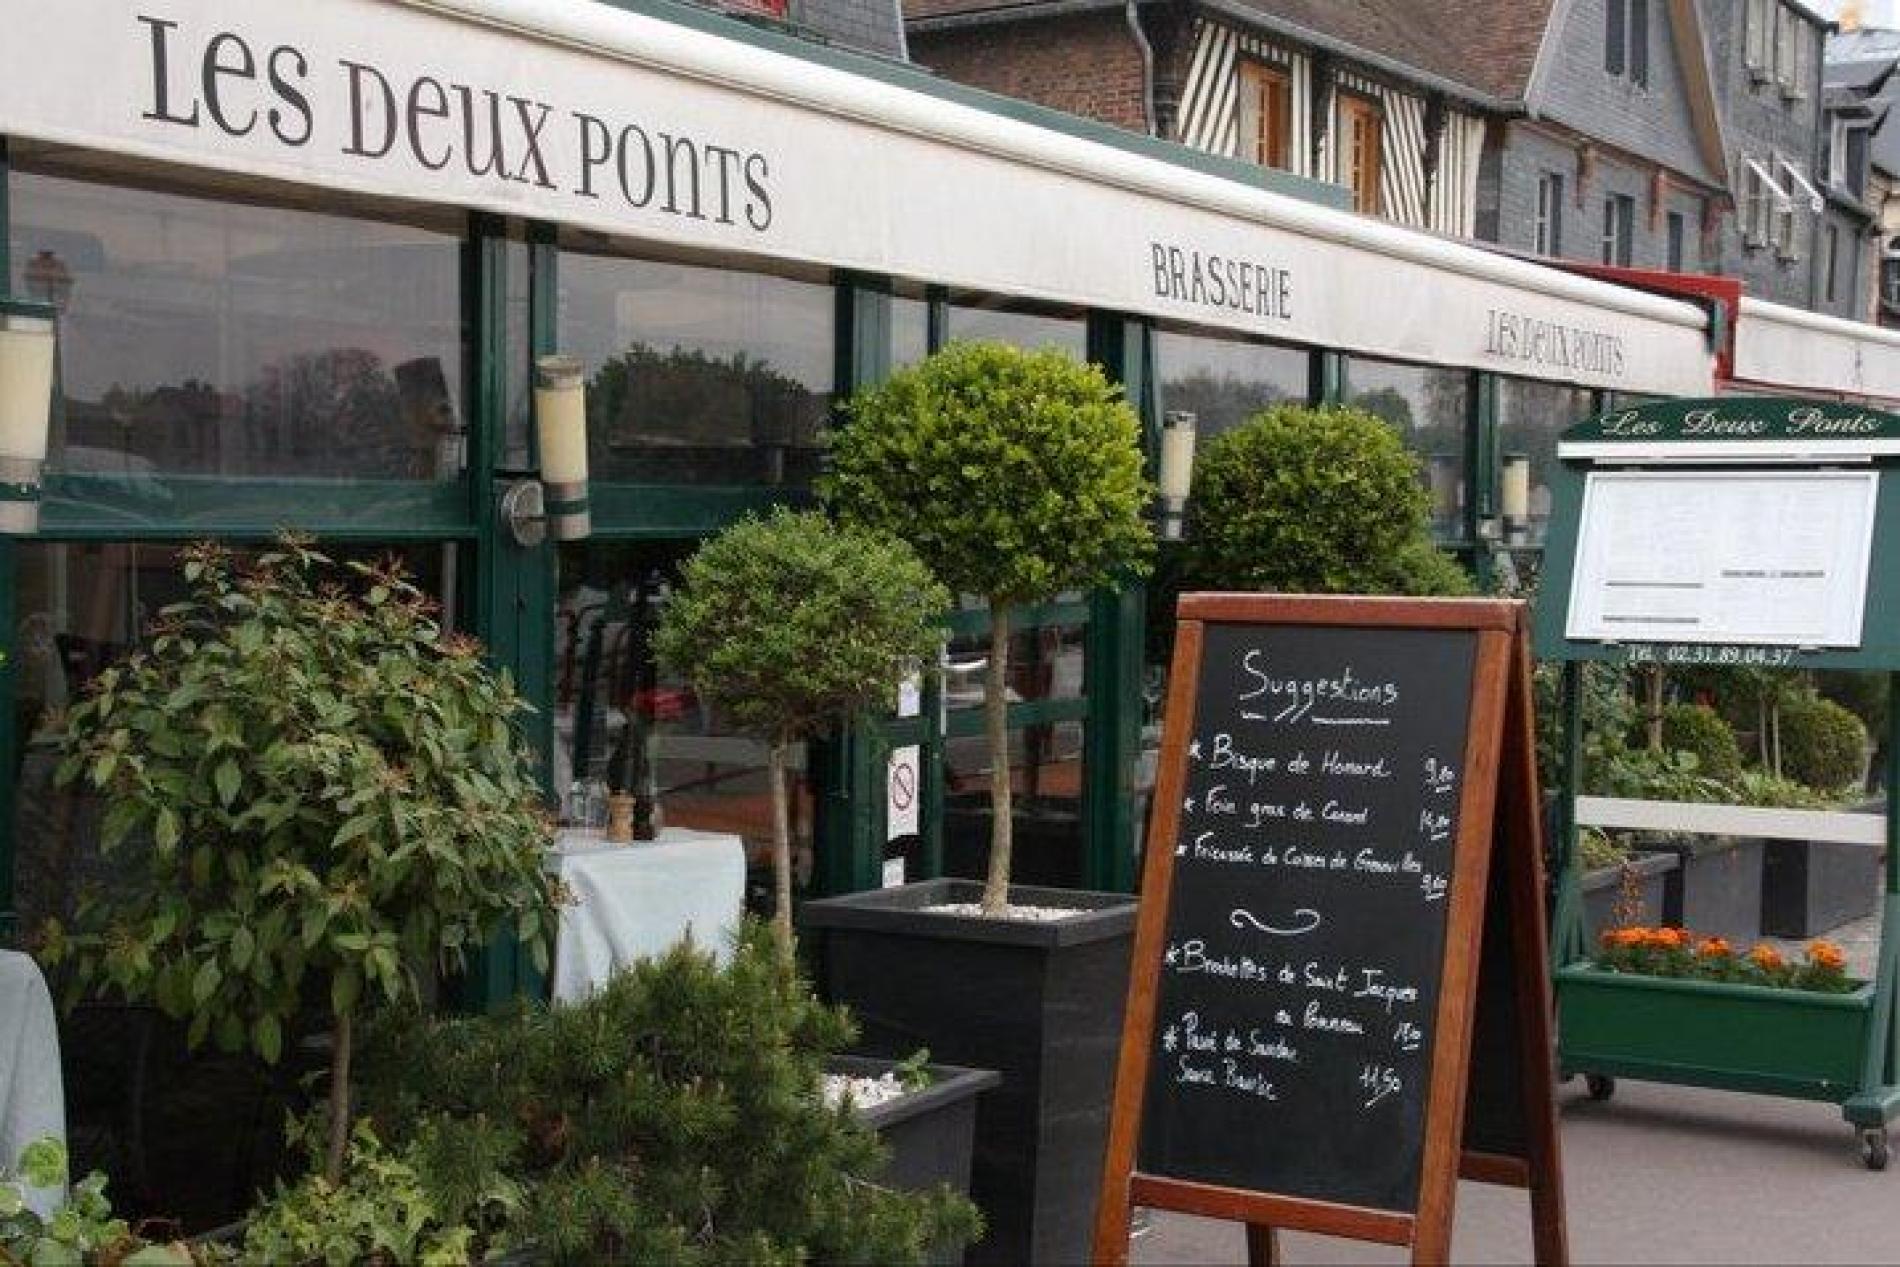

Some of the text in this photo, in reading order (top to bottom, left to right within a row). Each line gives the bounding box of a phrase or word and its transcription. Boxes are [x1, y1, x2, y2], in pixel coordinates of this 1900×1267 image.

[1150, 243, 1293, 320] BRASSERIE
[1599, 406, 1882, 436] Les Deux Ponts
[1239, 649, 1398, 723] Suggestions
[1209, 733, 1392, 784] Bisque de Homard
[1293, 801, 1314, 820] de
[1261, 846, 1278, 866] de
[1330, 851, 1347, 870] de
